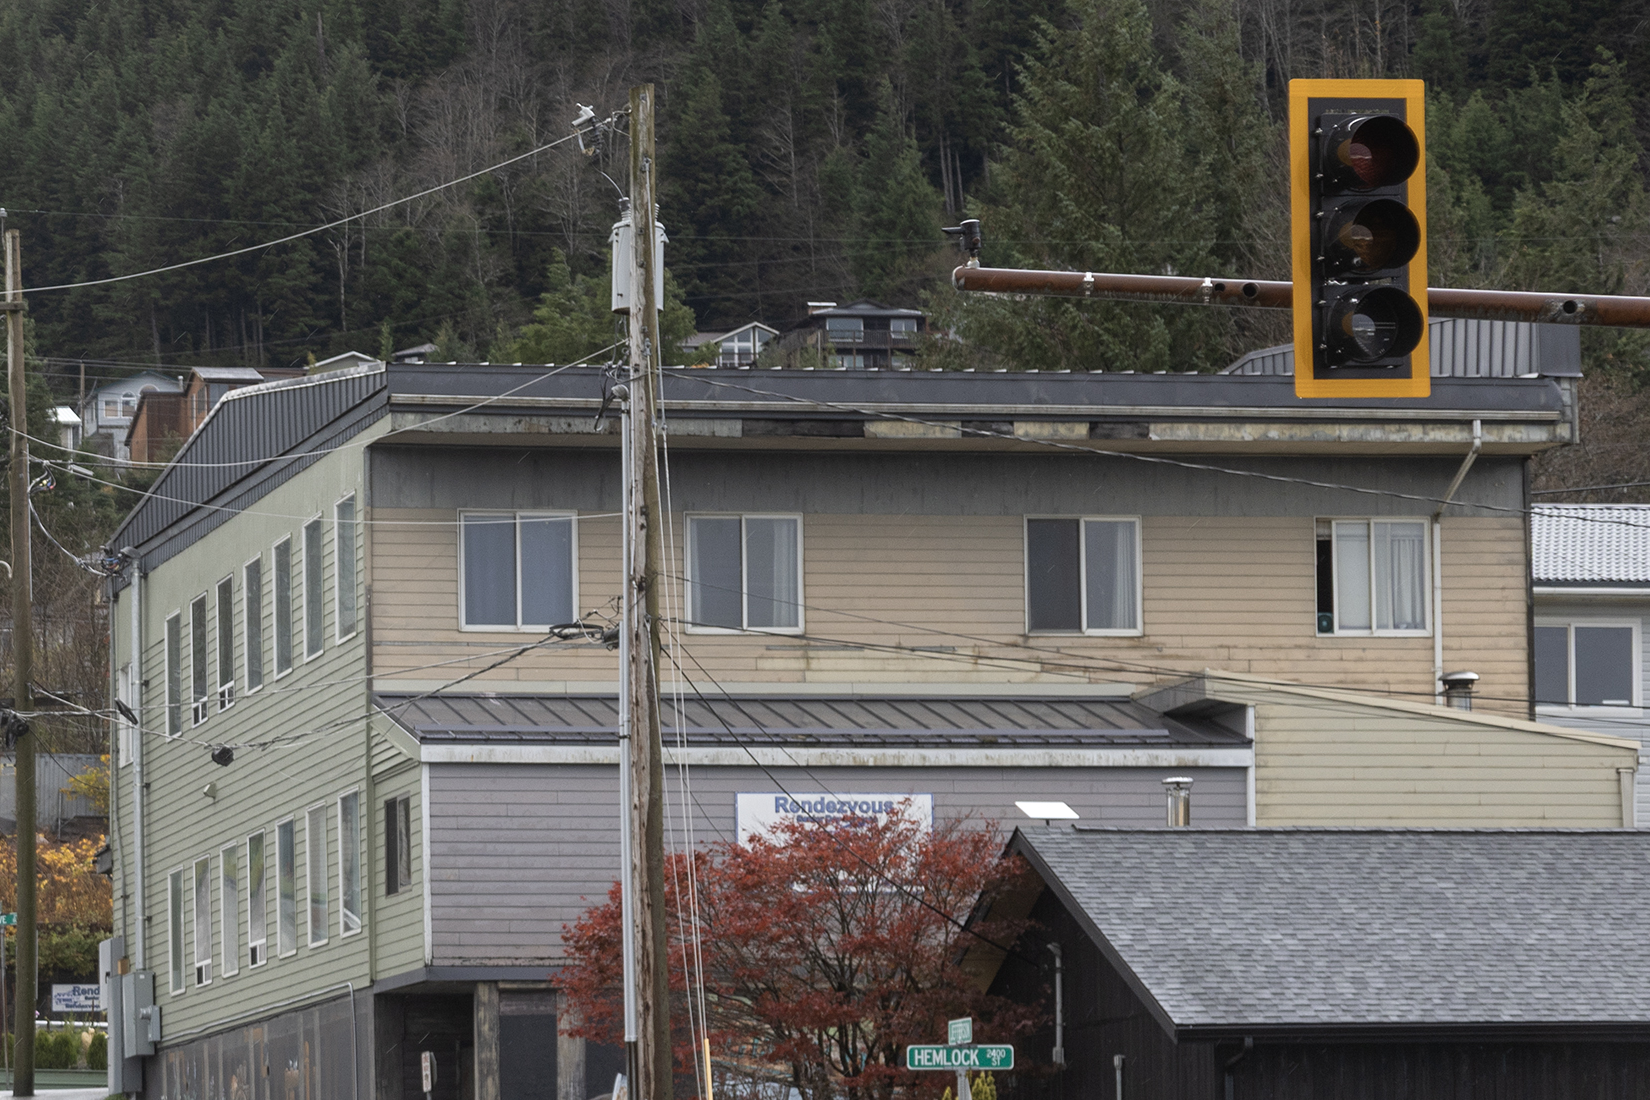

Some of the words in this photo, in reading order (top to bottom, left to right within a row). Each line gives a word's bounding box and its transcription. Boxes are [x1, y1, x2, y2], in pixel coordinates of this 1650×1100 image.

[774, 796, 894, 814] Rendezvous
[914, 1049, 979, 1066] HEMLOCK
[986, 1049, 1006, 1058] 2400
[991, 1057, 1001, 1066] ST
